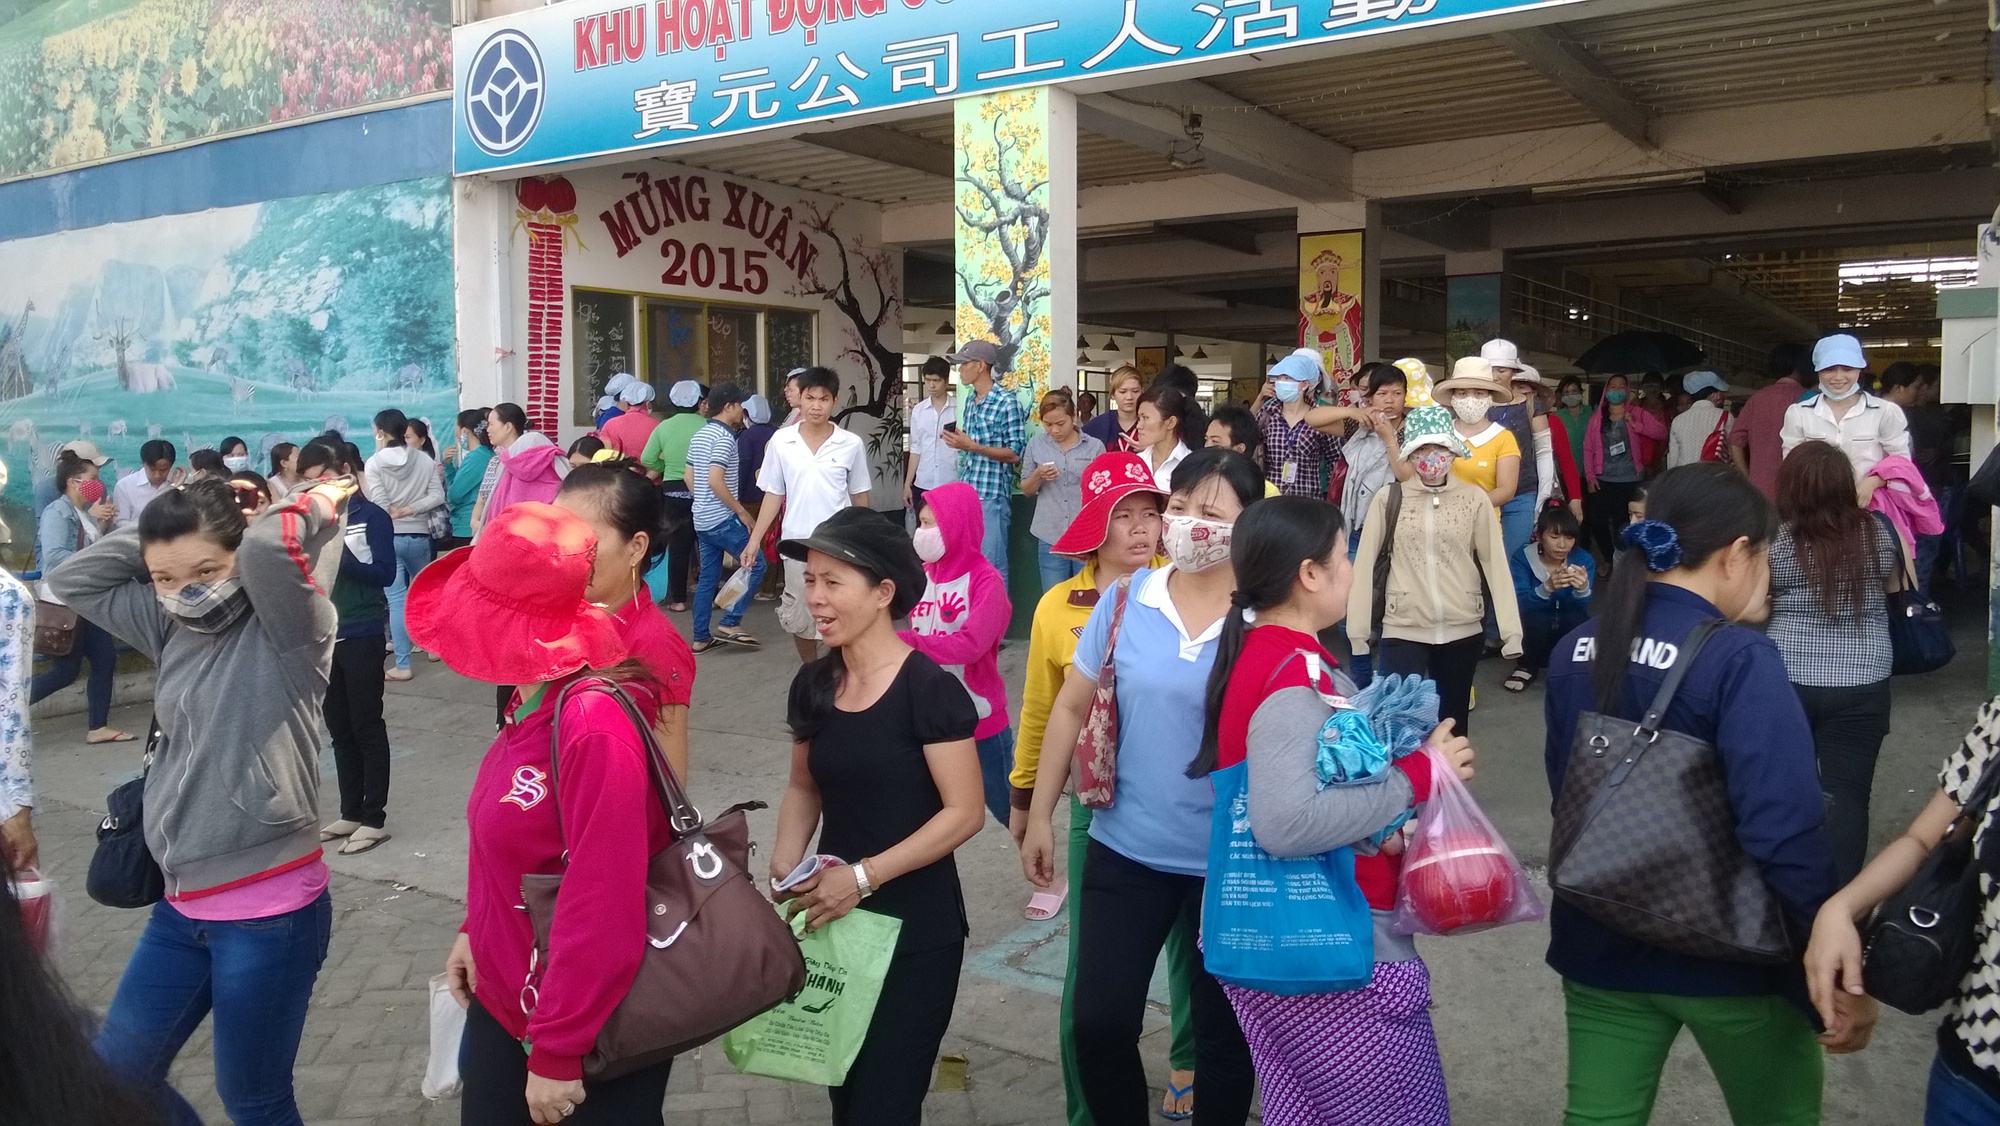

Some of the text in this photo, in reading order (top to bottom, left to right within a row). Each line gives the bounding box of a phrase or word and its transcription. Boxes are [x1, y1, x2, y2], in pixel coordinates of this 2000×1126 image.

[574, 3, 646, 73] KHU
[655, 0, 752, 61] HOẠT
[722, 180, 819, 280] XUÂN
[660, 238, 768, 295] 2015
[1571, 637, 1678, 670] ENAND
[499, 765, 548, 812] S
[806, 969, 846, 996] HÀNH
